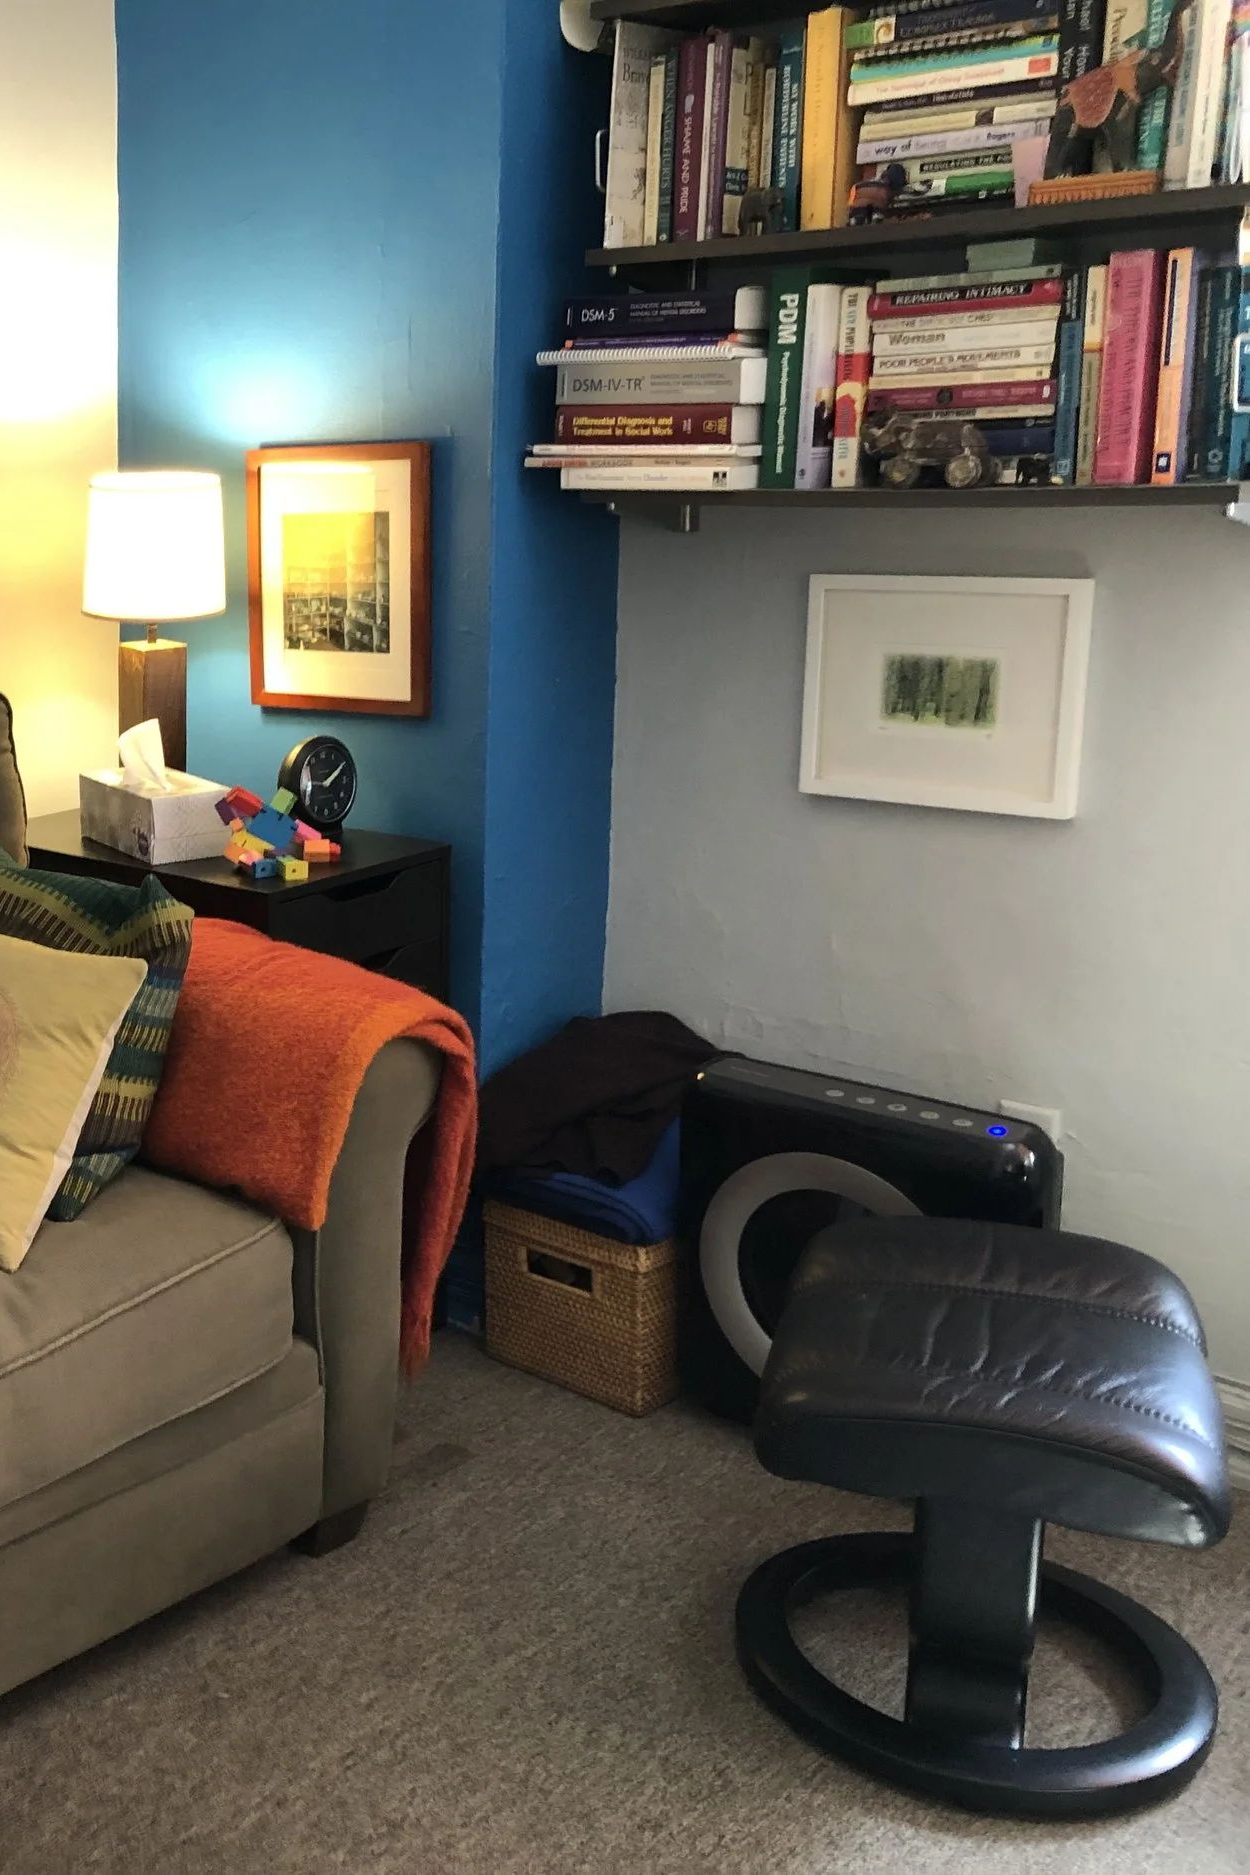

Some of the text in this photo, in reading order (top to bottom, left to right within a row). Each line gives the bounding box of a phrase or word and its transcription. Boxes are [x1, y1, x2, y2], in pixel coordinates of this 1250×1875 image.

[875, 145, 898, 156] way
[901, 139, 912, 151] of
[678, 117, 693, 214] SHAME AND PRIDE
[847, 293, 858, 308] THE
[895, 284, 1027, 305] REPAIRING INTIMACY
[581, 307, 616, 322] DSM-5
[777, 293, 800, 344] PDM
[888, 332, 946, 346] Woman
[879, 358, 906, 369] POOR
[572, 416, 615, 427] Differential
[617, 416, 656, 428] Diagnosis
[658, 416, 673, 426] and
[573, 427, 674, 437] Treatment in Social Work
